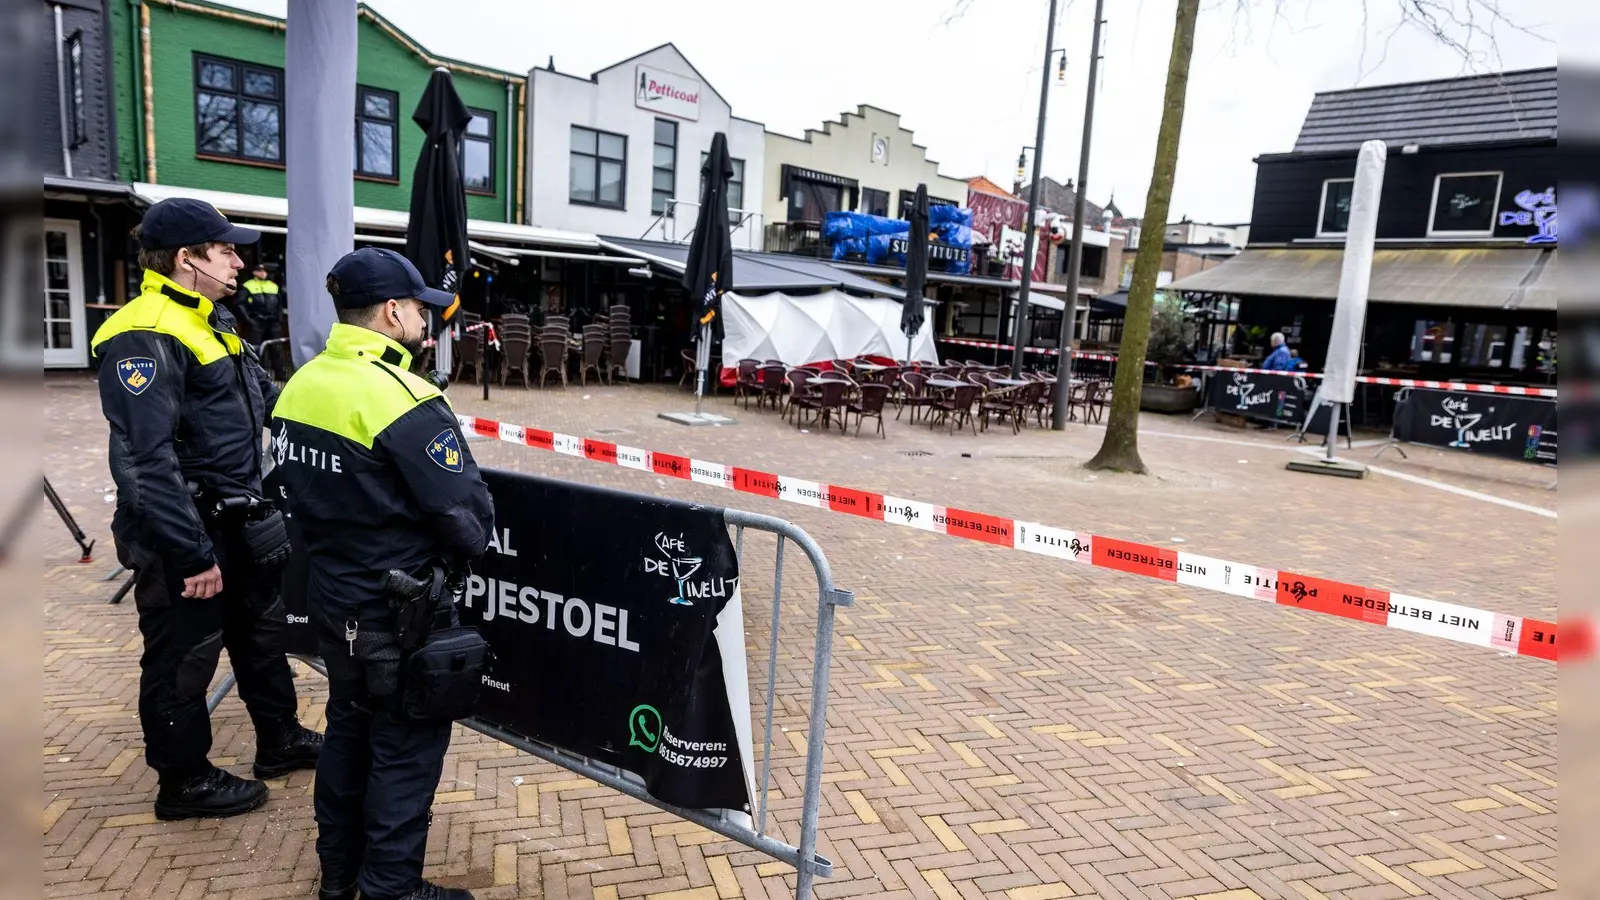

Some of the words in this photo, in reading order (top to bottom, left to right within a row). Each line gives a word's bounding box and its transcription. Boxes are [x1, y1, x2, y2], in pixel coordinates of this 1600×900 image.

[648, 80, 698, 104] Petticoat
[1499, 210, 1532, 226] DE
[892, 239, 967, 261] SUTITUTE
[120, 361, 153, 370] POLITIE
[1226, 385, 1239, 396] DE
[1430, 414, 1452, 428] DE
[272, 430, 342, 474] POLITIE
[431, 433, 454, 454] POLITIE
[629, 454, 641, 463] NIET
[655, 460, 682, 474] POLITIE
[690, 467, 721, 479] BETREDEN
[723, 474, 737, 482] NIET
[753, 478, 787, 495] POLITIE
[797, 488, 836, 502] BETREDEN
[838, 495, 856, 505] NIET
[877, 503, 919, 522] POLITIE
[933, 514, 982, 531] BETREDEN
[986, 525, 1007, 536] NIET
[655, 532, 686, 558] CAFÉ
[1035, 534, 1089, 557] POLITIE
[644, 557, 670, 577] DE
[1107, 548, 1173, 569] BETREDEN
[1177, 562, 1206, 576] NIET
[1244, 575, 1318, 603] POLITIE
[1342, 594, 1432, 621] BETREDEN
[1438, 613, 1479, 630] NIET
[481, 674, 511, 692] Pineut
[663, 725, 727, 751] Reserveren:
[659, 743, 728, 768] 0615674997
